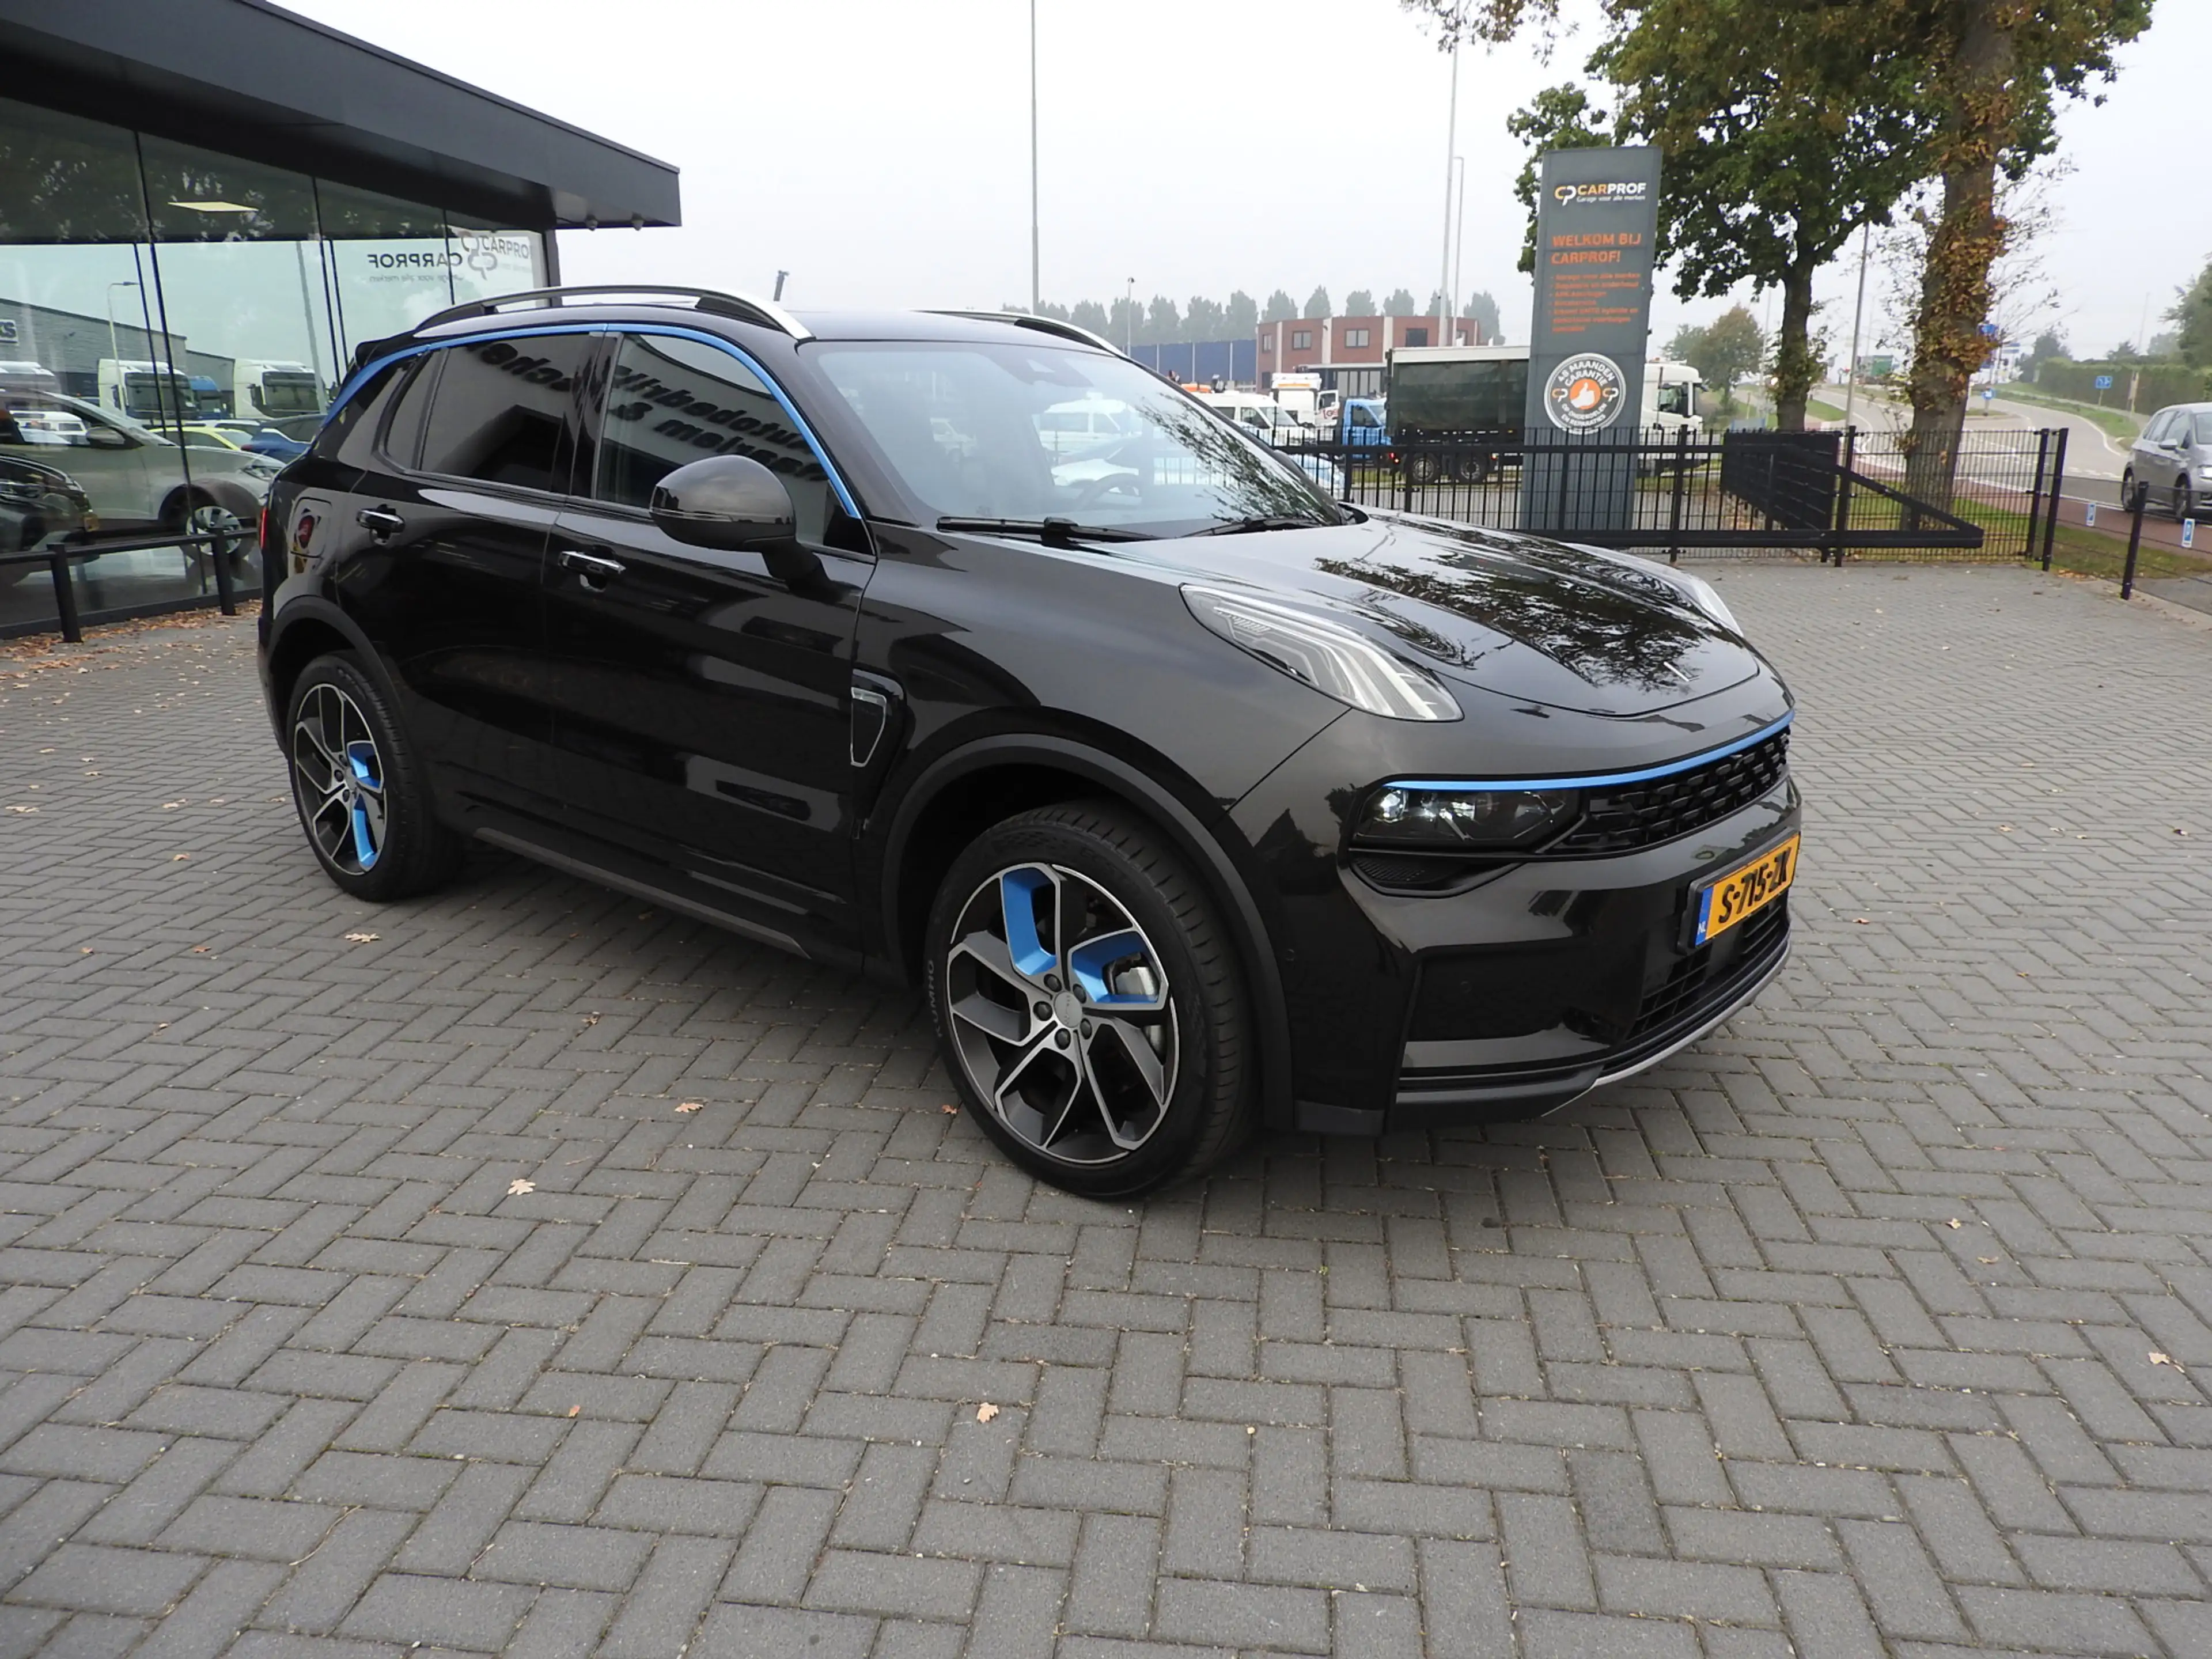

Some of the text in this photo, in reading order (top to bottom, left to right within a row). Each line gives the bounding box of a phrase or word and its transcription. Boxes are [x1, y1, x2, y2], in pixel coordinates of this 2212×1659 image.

[1578, 183, 1647, 196] CARPROF
[1552, 232, 1641, 247] WELKOM BIJ
[1551, 250, 1621, 265] CARPROF!
[1558, 361, 1615, 382] 48 MAANDEN
[1565, 370, 1609, 387] GARANTIE
[1697, 921, 1706, 935] NL
[927, 959, 943, 1037] KUMHO
